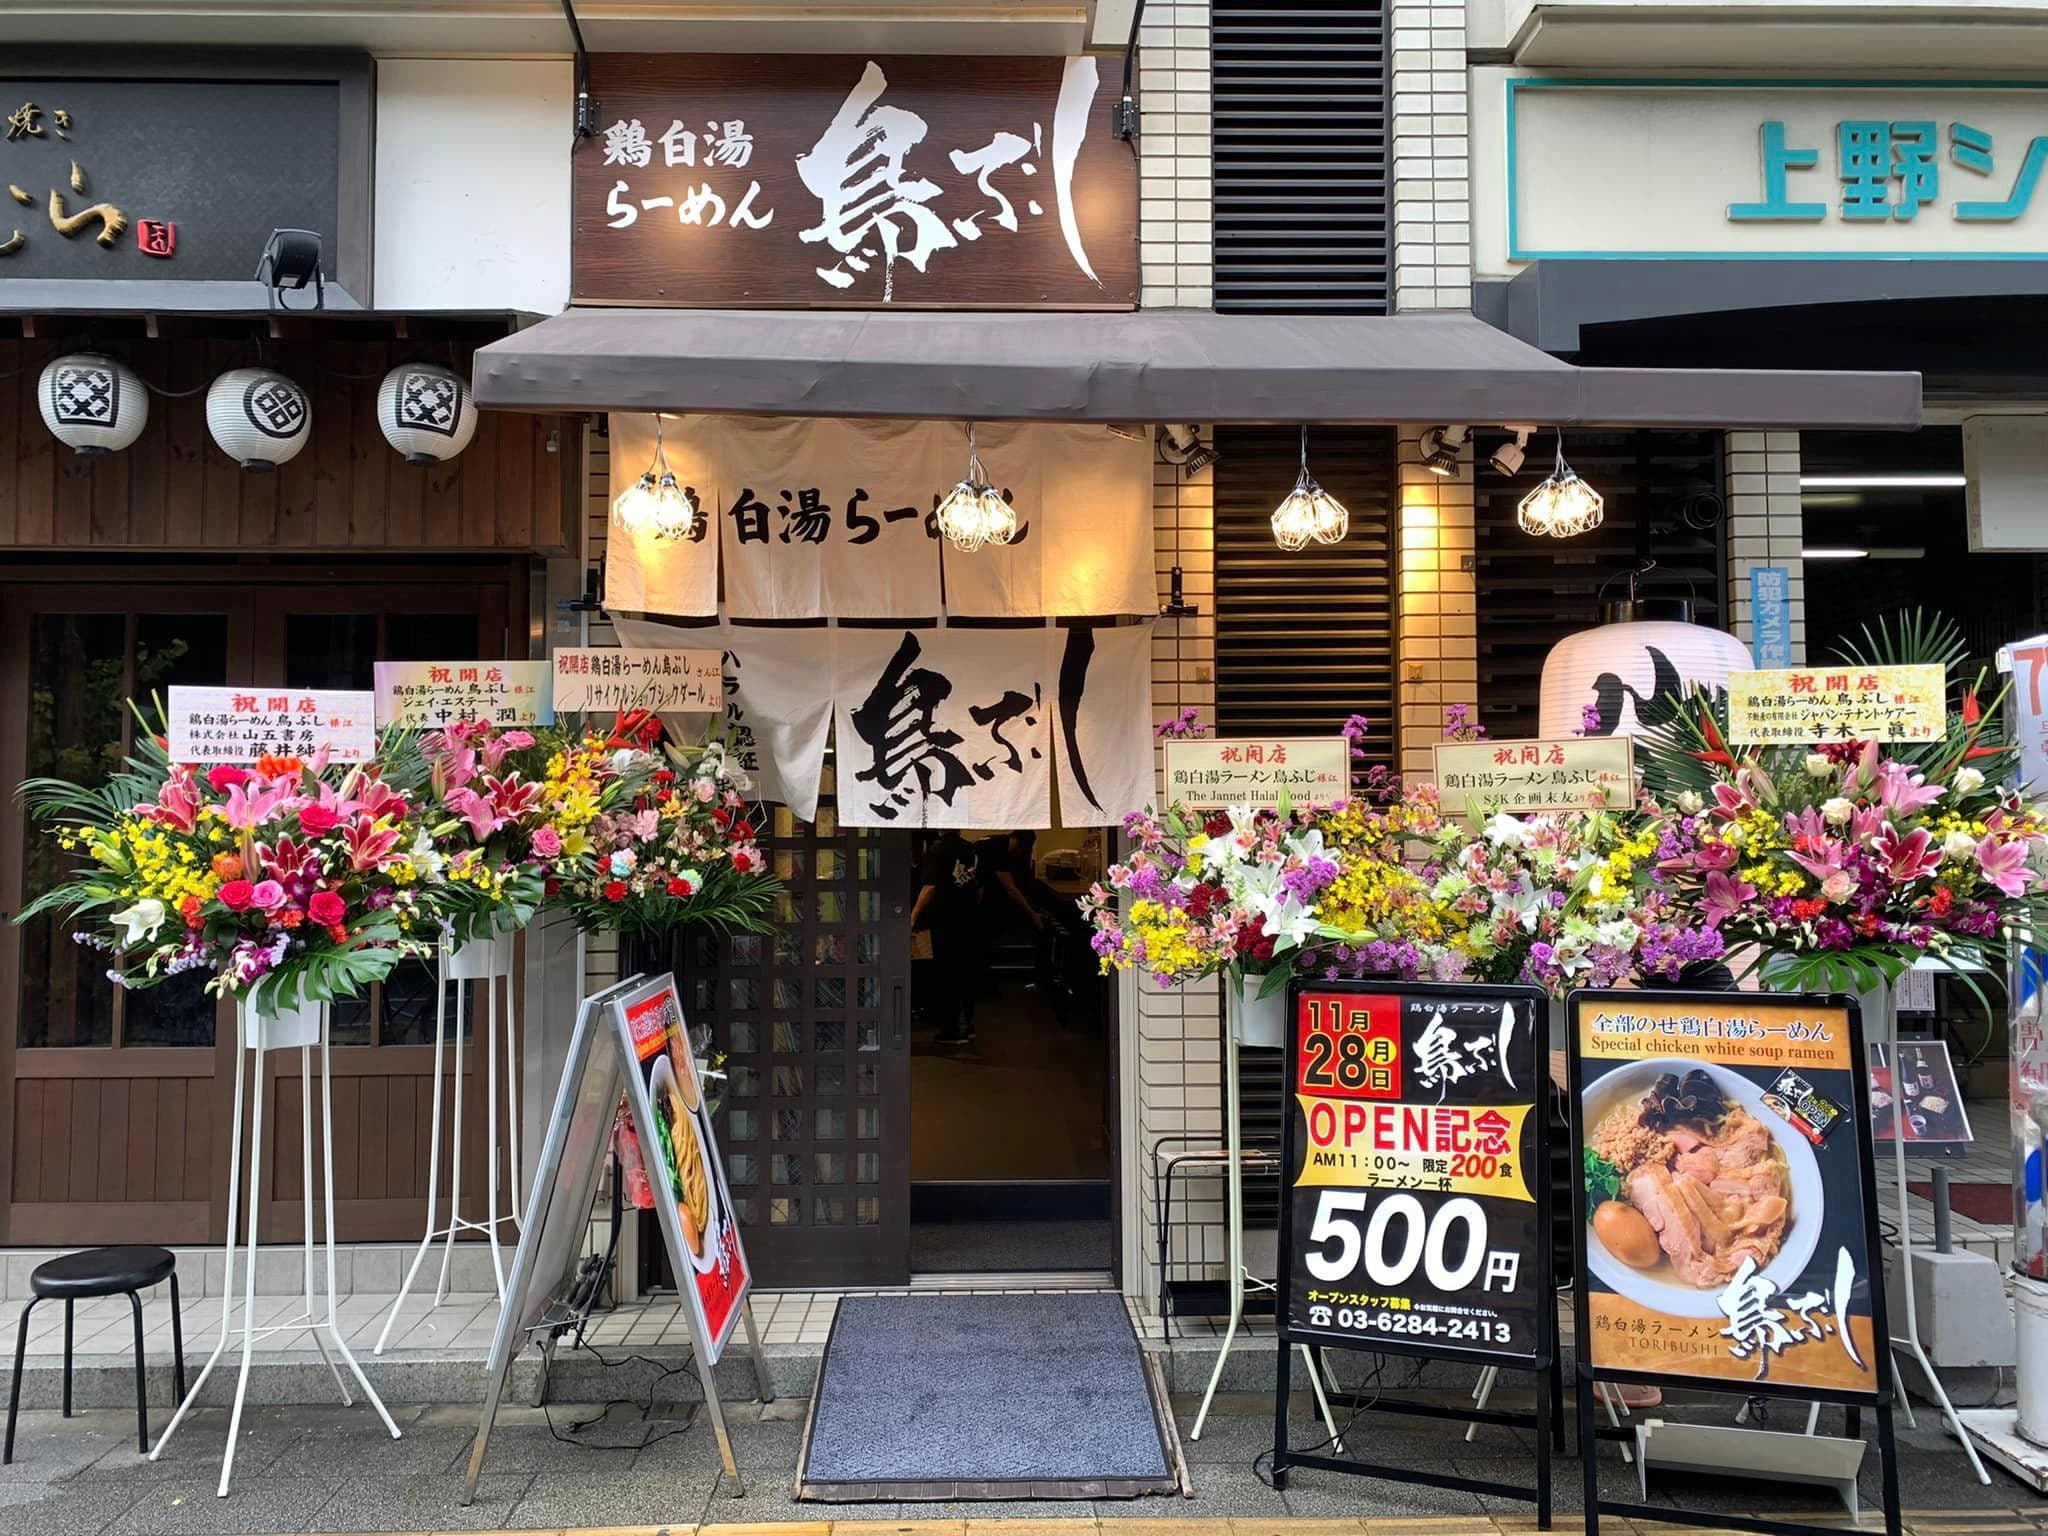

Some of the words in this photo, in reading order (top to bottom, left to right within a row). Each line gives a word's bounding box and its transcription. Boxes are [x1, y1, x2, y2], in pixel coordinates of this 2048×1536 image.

[602, 119, 754, 169] 鶏白湯
[605, 180, 775, 230] らーめん
[429, 666, 504, 684] 祝開店
[1788, 673, 1880, 694] 祝開店
[231, 693, 318, 714] 祝開店
[1220, 744, 1289, 765] 祝開店
[1493, 744, 1566, 767] 祝開店
[1185, 790, 1207, 801] The
[1210, 790, 1248, 801] Jannet
[1251, 790, 1279, 801] Halal
[1288, 790, 1311, 801] ood
[1591, 1036, 1641, 1053] Special
[1646, 1038, 1700, 1054] chicken
[1704, 1040, 1744, 1055] white
[1749, 1046, 1784, 1060] soup
[1787, 1048, 1834, 1060] ramen
[1338, 1308, 1511, 1343] 03-6284-2413
[1631, 1337, 1719, 1356] 鳥BUSHI
